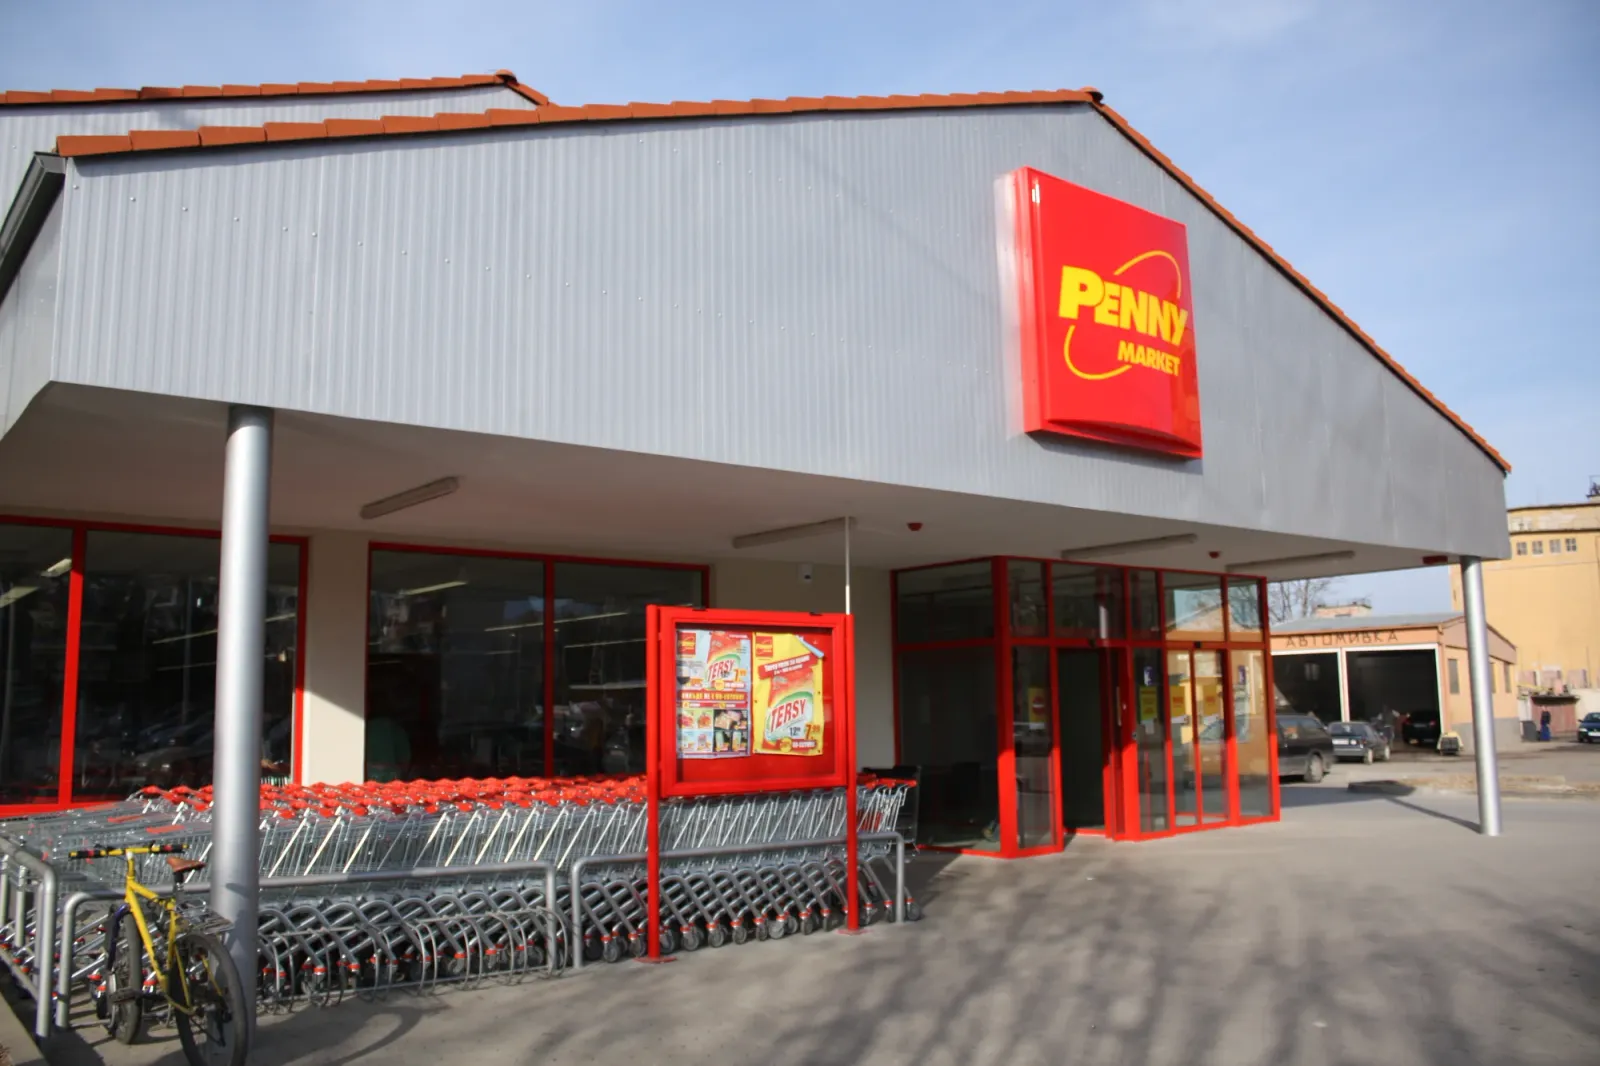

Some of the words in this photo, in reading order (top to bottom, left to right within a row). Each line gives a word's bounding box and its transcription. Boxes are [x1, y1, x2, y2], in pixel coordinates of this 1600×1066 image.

[1058, 265, 1189, 347] PENNY
[1117, 340, 1181, 377] MARKET
[1285, 630, 1399, 648] АВТОМИВКА
[770, 698, 807, 733] TERSY
